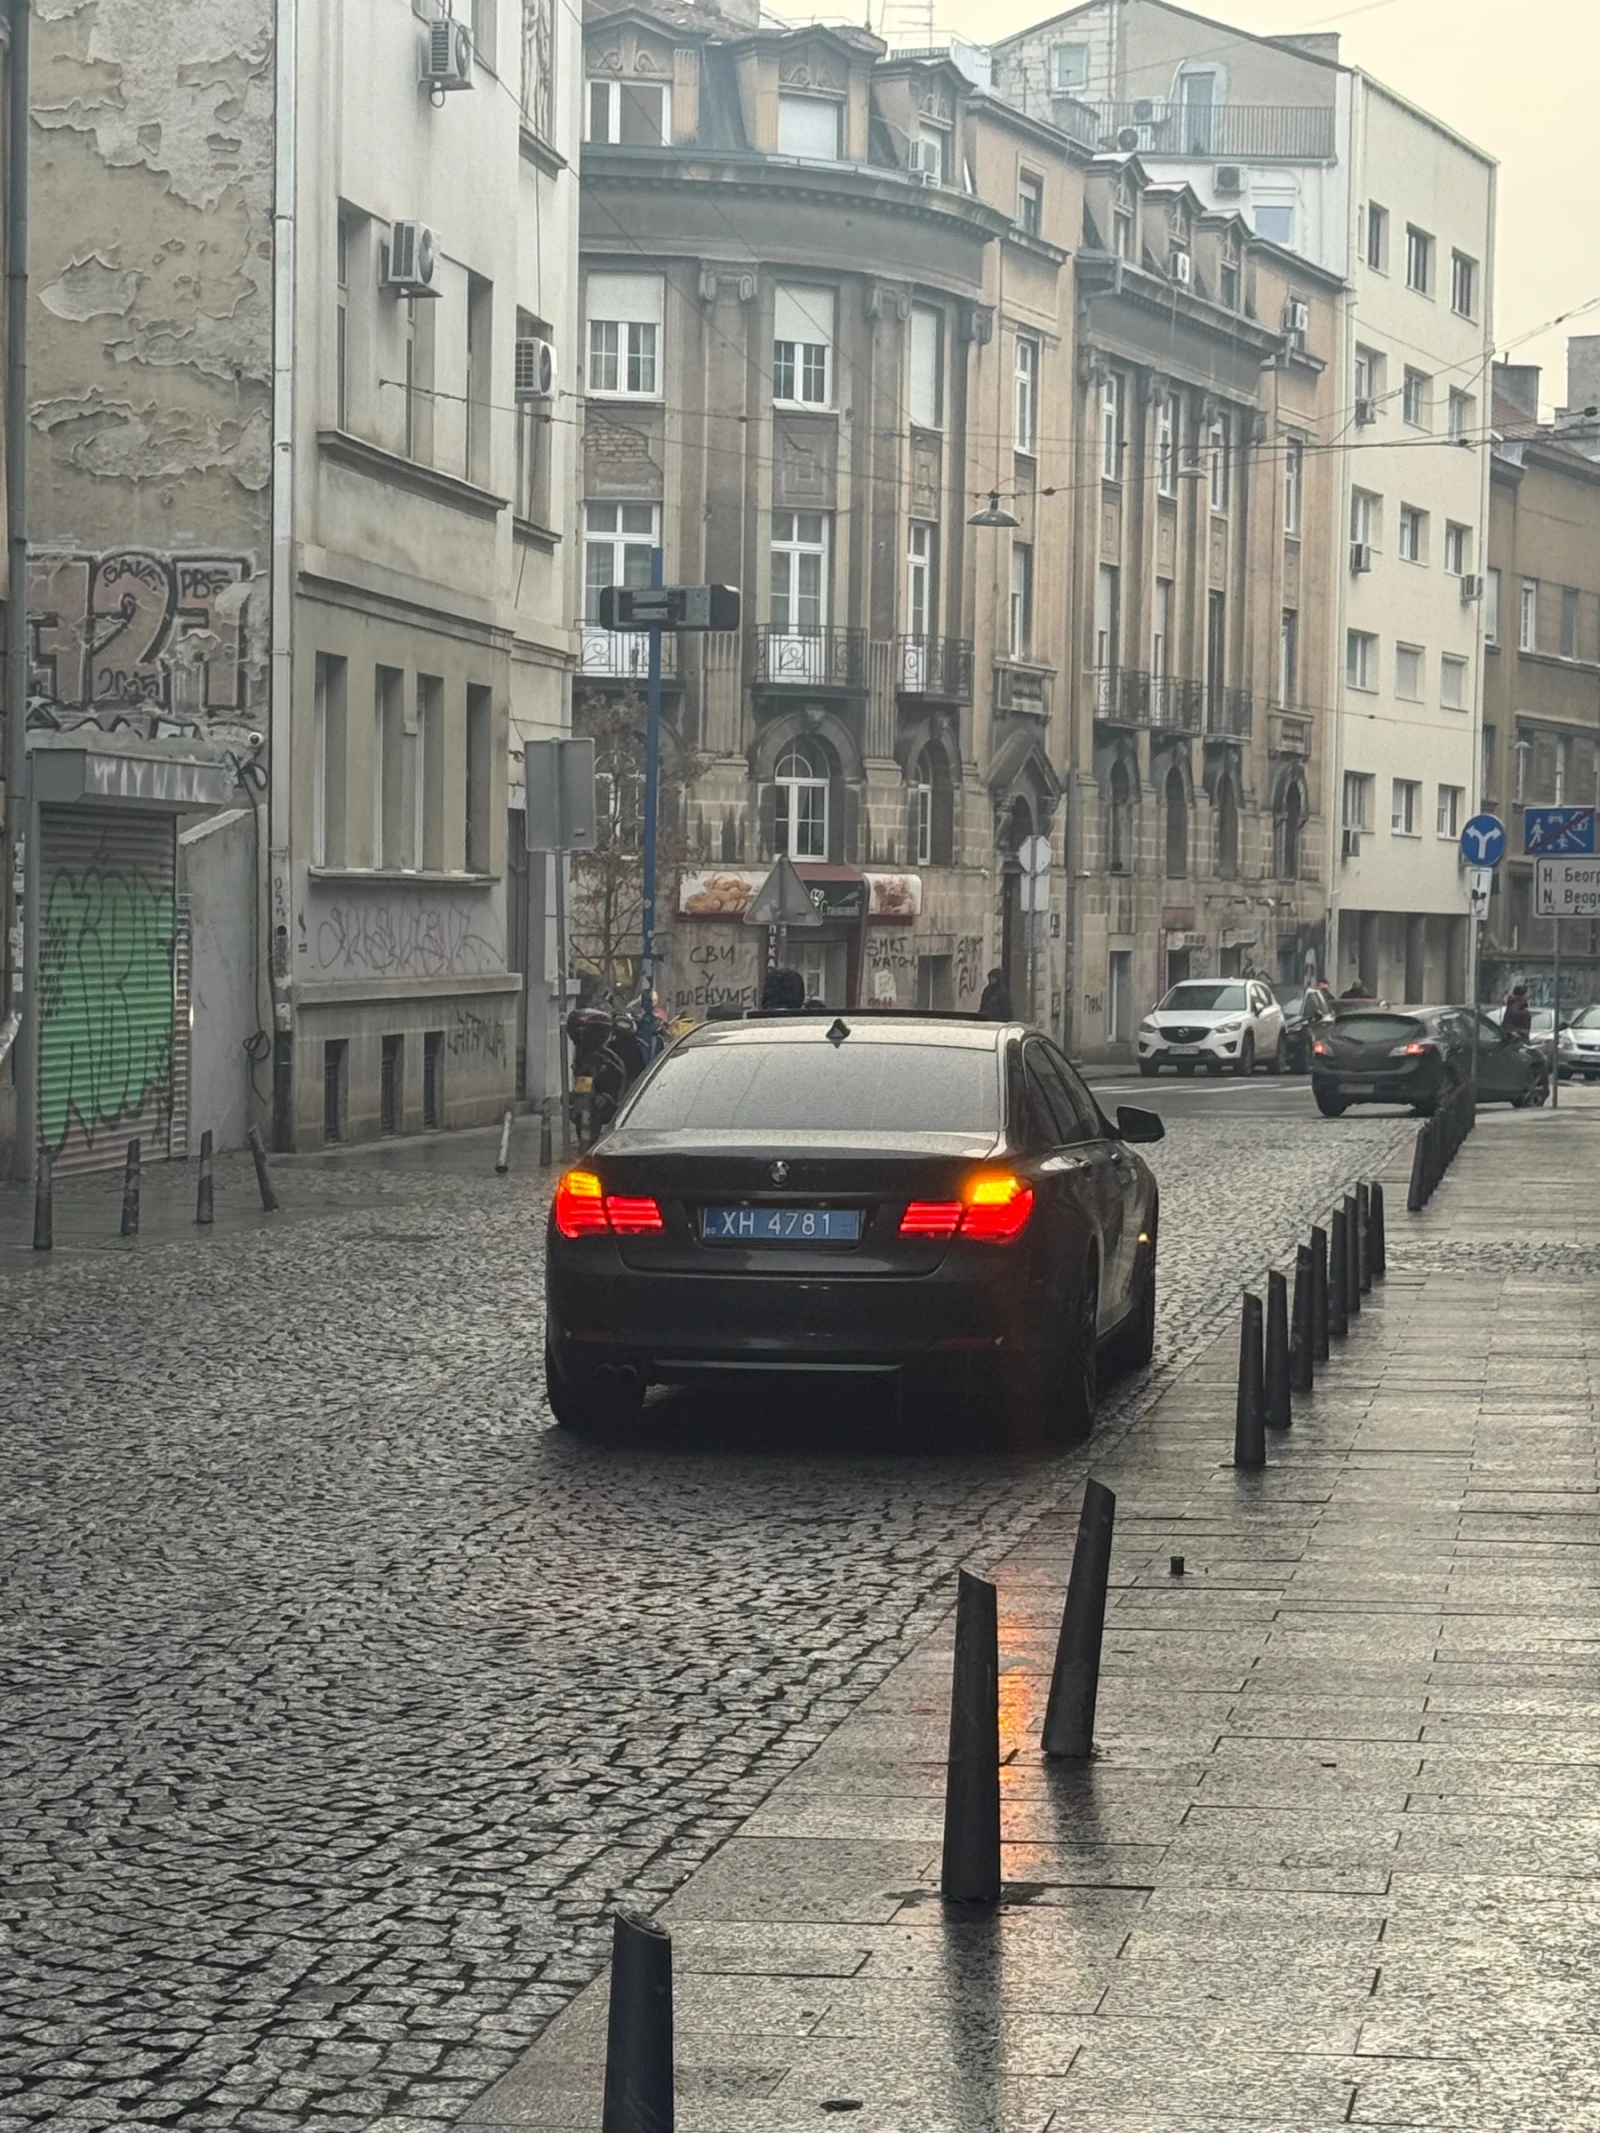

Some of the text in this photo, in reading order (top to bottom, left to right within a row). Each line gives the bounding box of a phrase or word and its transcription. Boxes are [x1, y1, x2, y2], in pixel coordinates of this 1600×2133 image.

[689, 945, 736, 965] СВИ
[767, 925, 777, 973] ПЕКА
[866, 936, 908, 957] SMRT
[721, 1211, 754, 1236] XH
[767, 1212, 832, 1236] 4781
